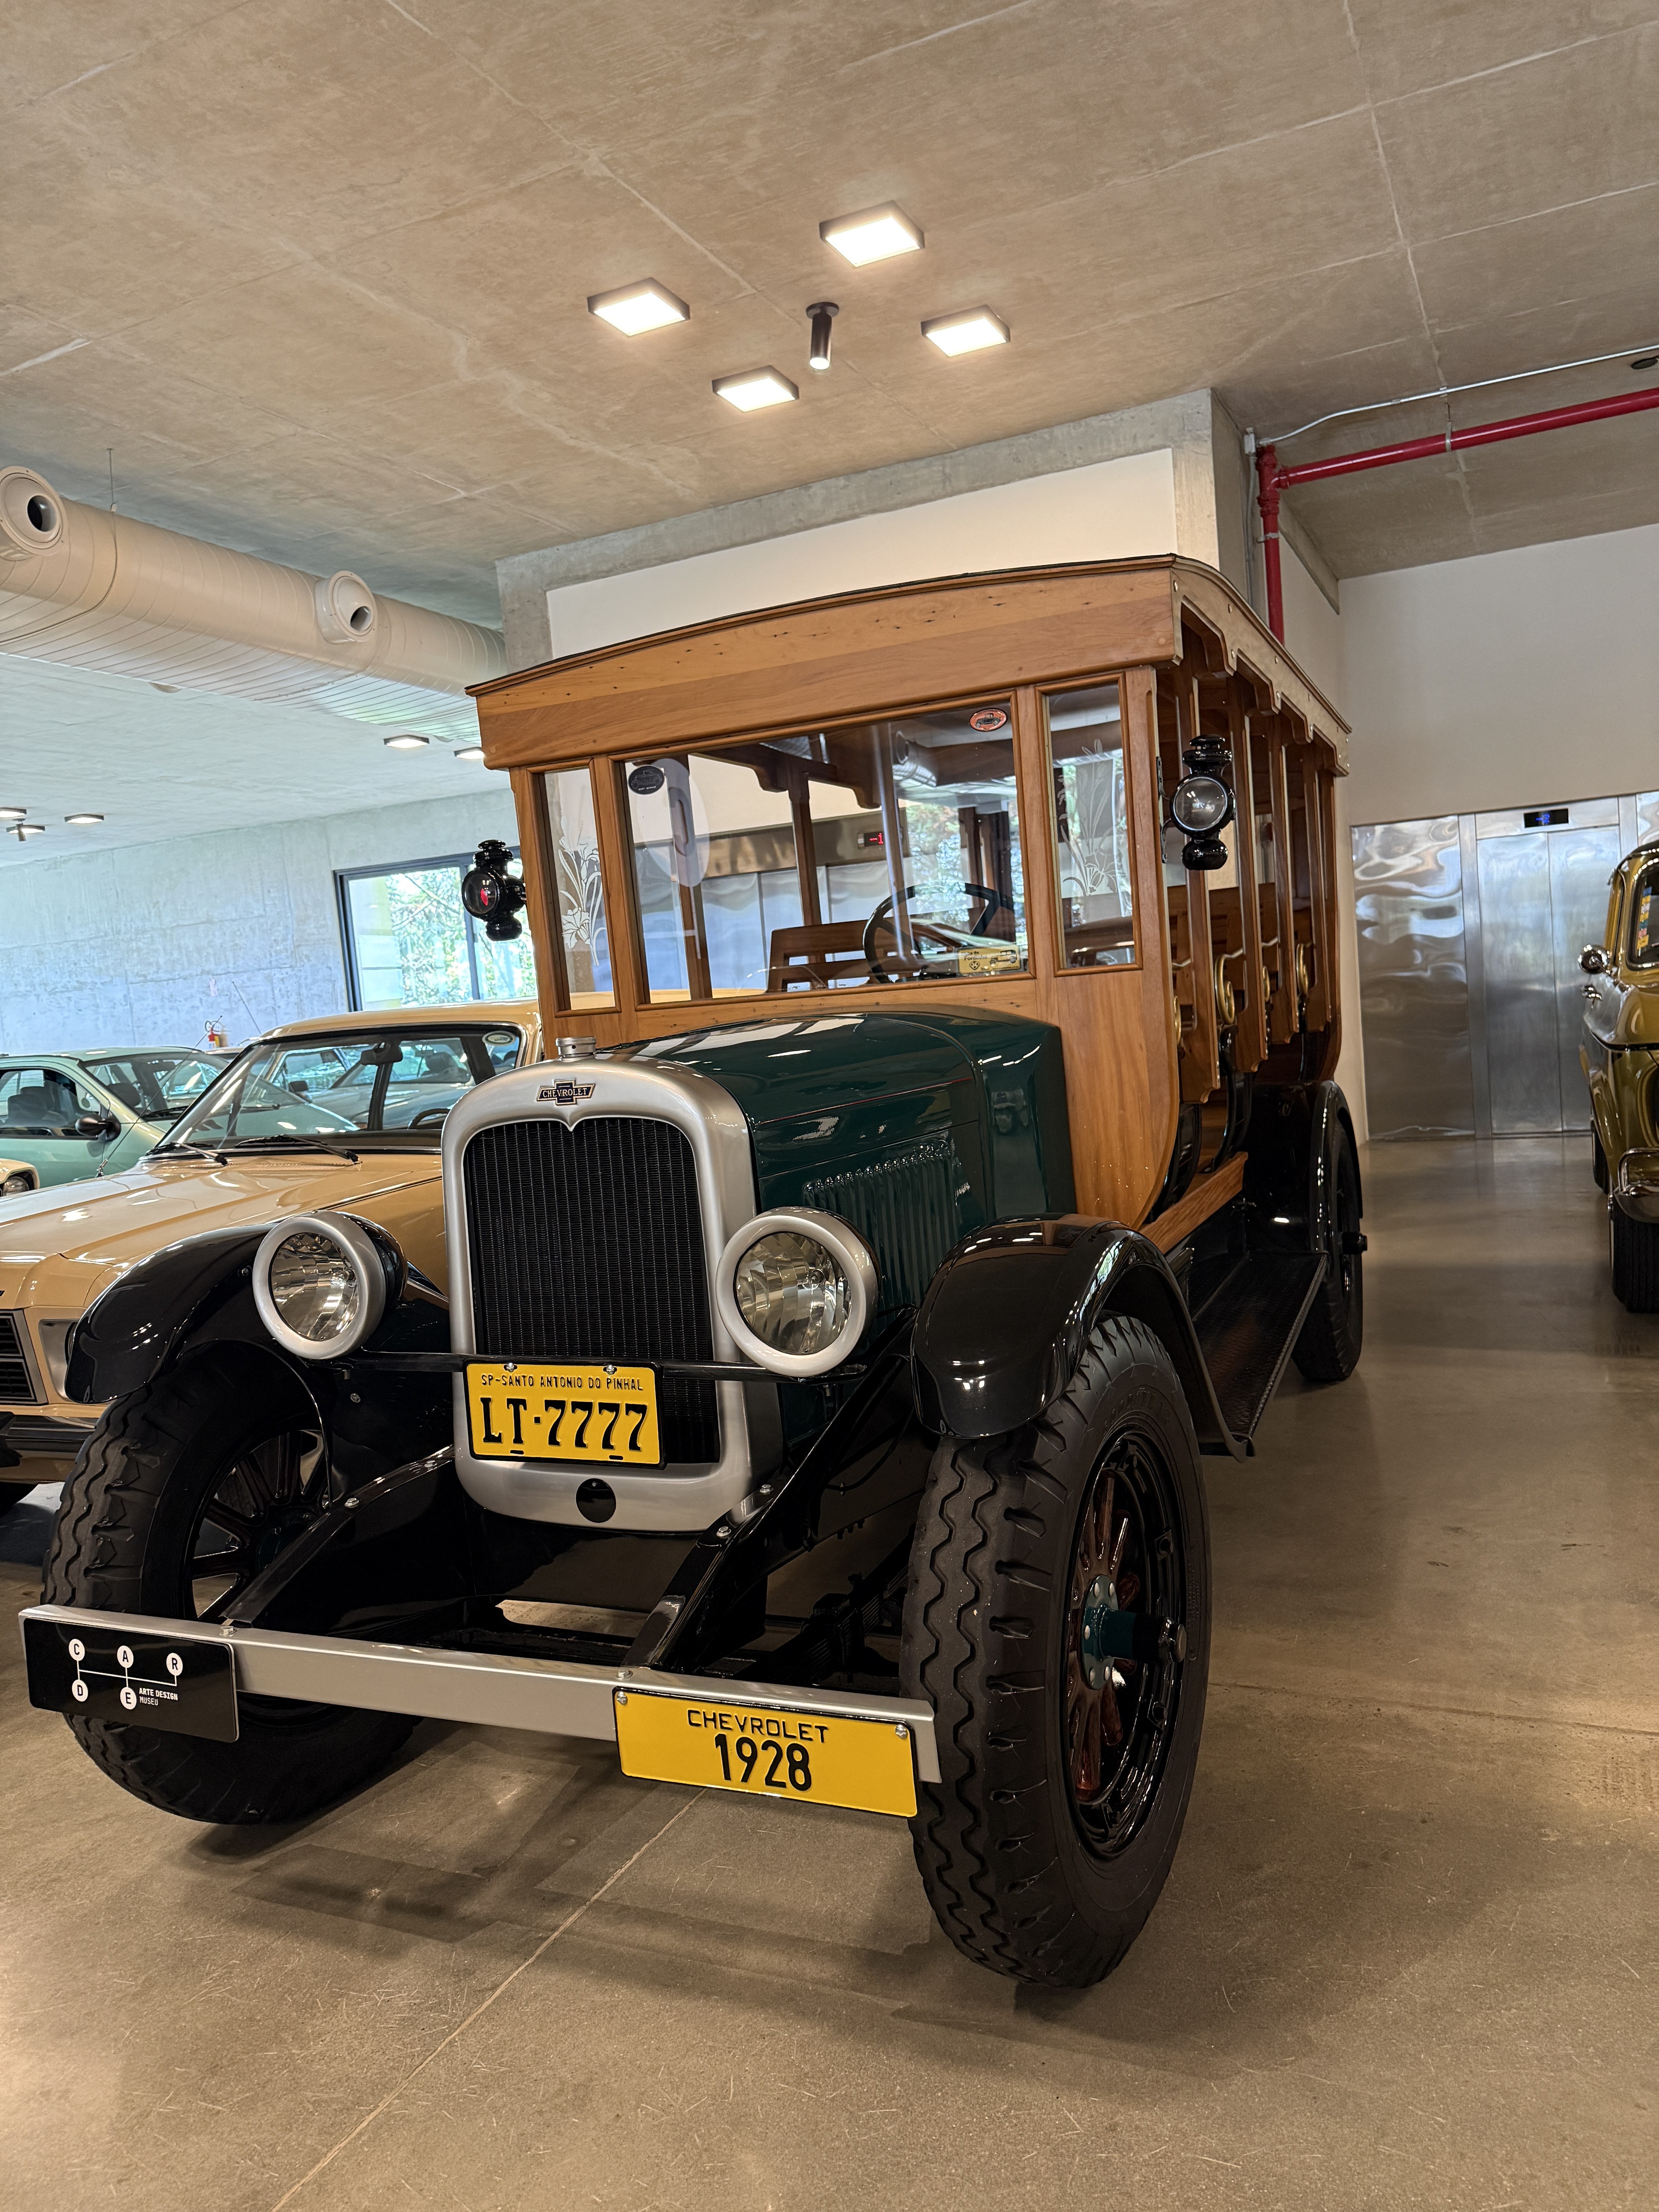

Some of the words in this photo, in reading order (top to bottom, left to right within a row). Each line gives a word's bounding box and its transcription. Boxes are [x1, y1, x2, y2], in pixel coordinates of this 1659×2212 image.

[870, 833, 883, 844] -1
[543, 1087, 587, 1097] CHEVROLET
[481, 1374, 534, 1386] SP-SANTO
[540, 1376, 582, 1389] ANTONIO
[588, 1377, 601, 1389] DO
[606, 1377, 643, 1391] PINHAL
[139, 1687, 154, 1697] ARTE
[156, 1690, 178, 1701] DESIGN
[139, 1696, 158, 1706] MUSEU
[687, 1709, 829, 1743] CHEVROLET
[714, 1733, 812, 1791] 1928
